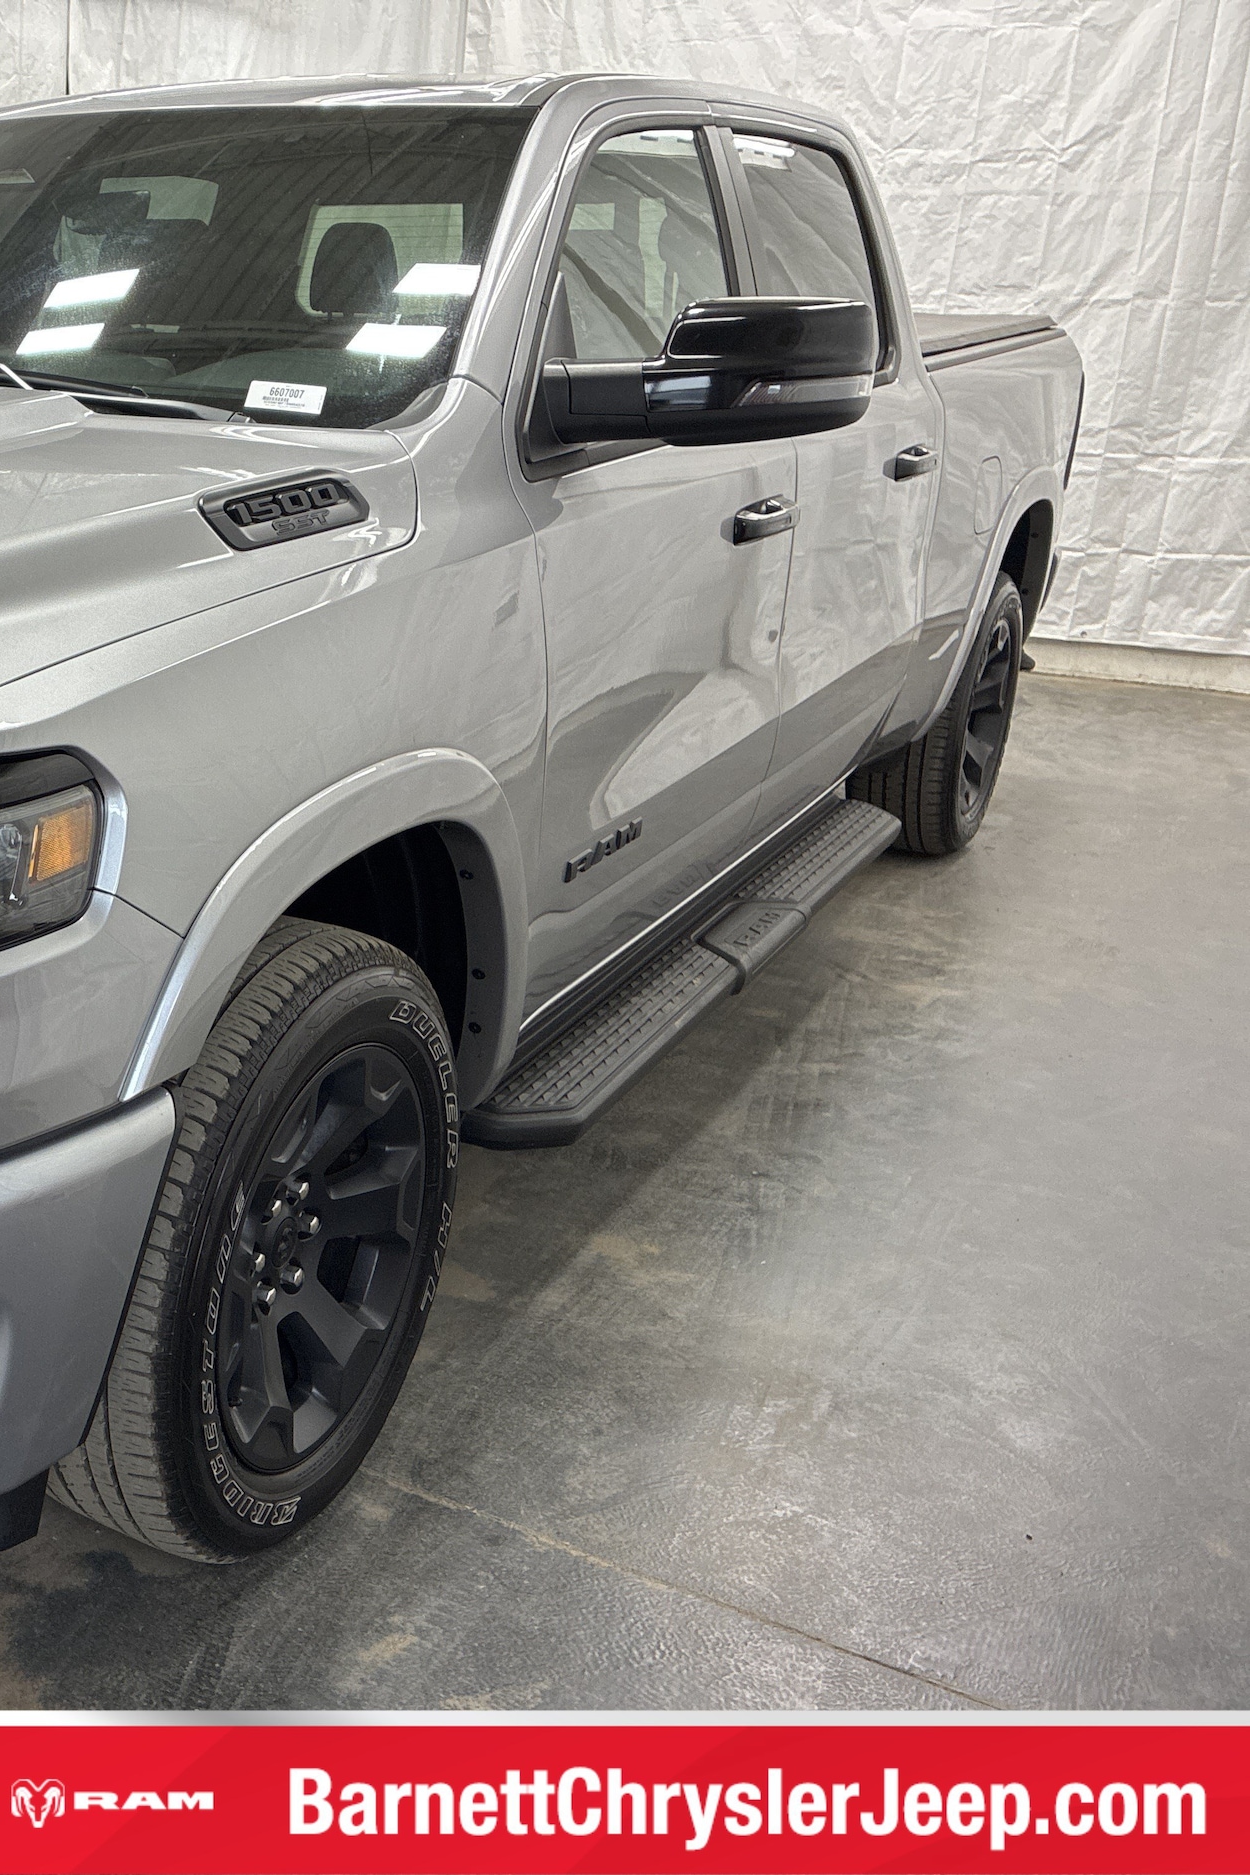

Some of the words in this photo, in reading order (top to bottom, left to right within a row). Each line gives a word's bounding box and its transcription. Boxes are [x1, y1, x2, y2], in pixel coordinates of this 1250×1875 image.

[269, 386, 306, 399] 6607007
[228, 483, 341, 525] 1500
[271, 509, 331, 537] SST
[561, 816, 643, 884] RAM
[389, 1000, 459, 1169] DUELER
[202, 1178, 302, 1526] BRIDGESTONE
